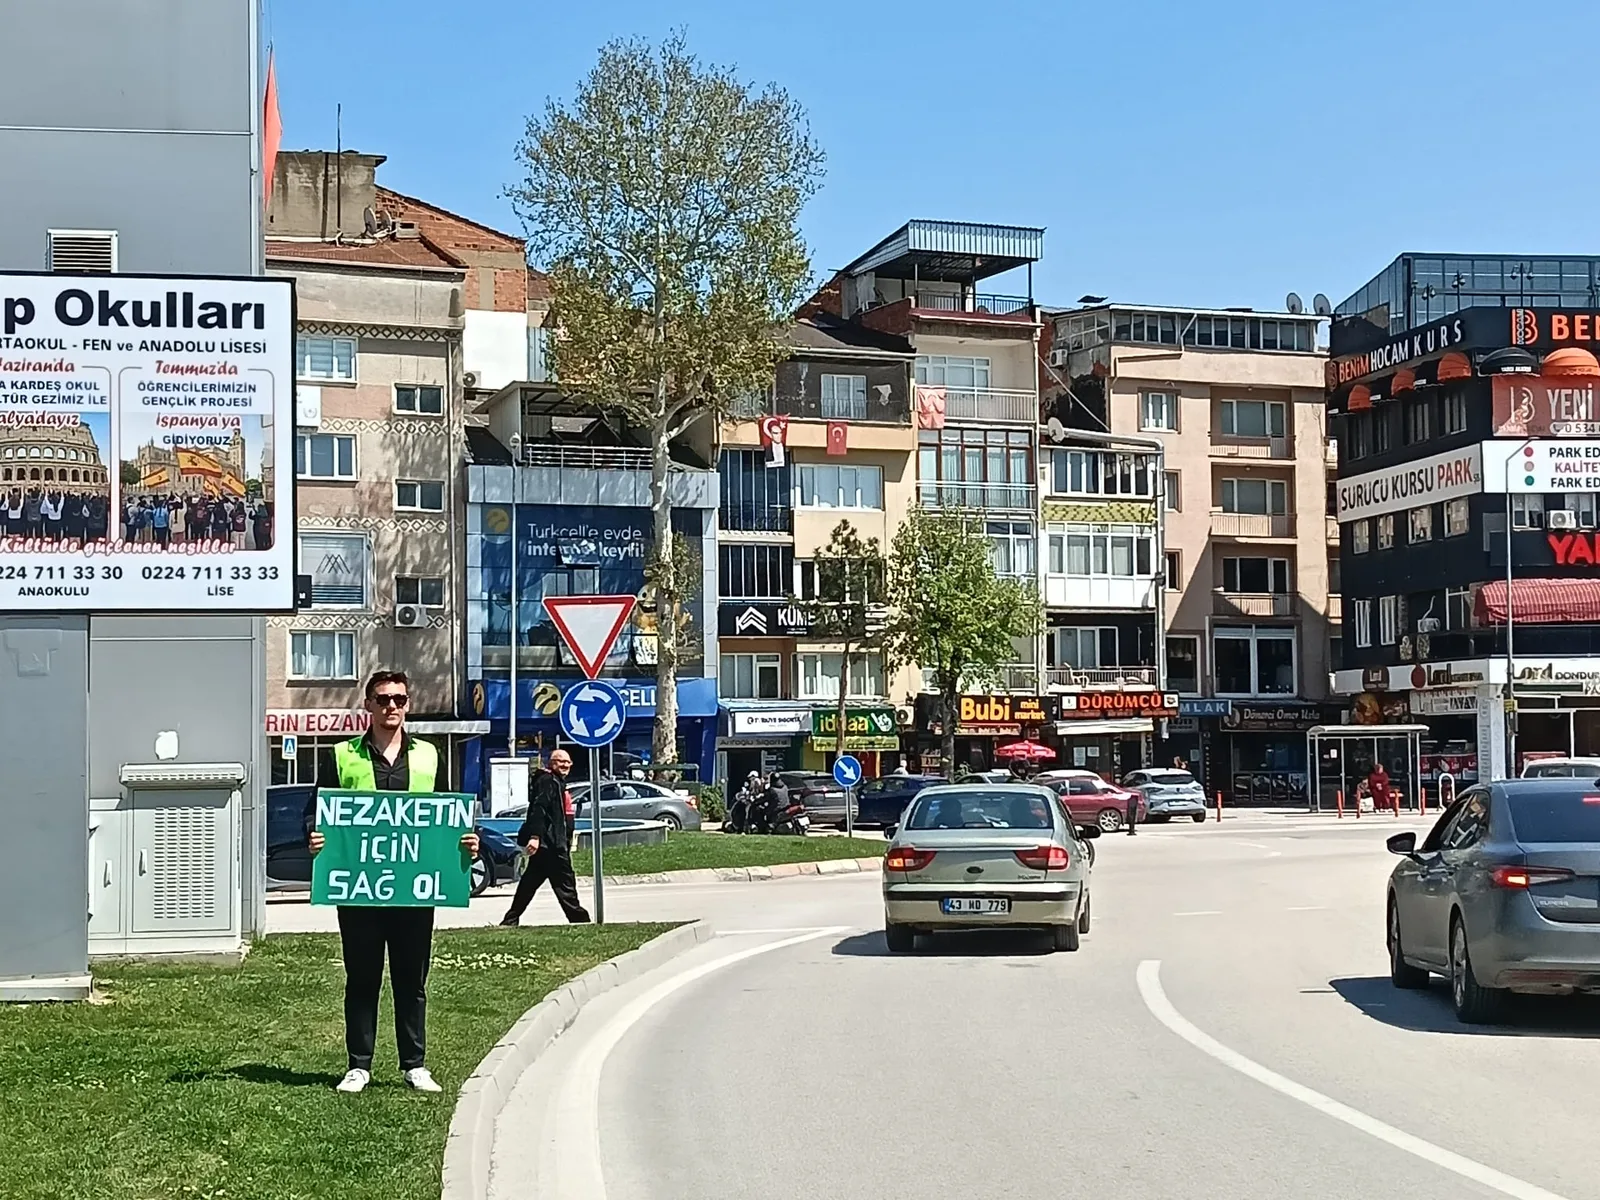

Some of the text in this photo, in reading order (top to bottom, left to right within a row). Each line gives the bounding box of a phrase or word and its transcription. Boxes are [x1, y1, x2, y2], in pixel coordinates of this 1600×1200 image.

[54, 288, 265, 330] Okulları
[83, 339, 112, 351] FEN
[117, 342, 133, 351] ve
[138, 340, 216, 353] ANADOLU
[220, 338, 267, 354] LİSESİ
[1370, 339, 1409, 372] HOCAM
[155, 360, 238, 376] Temmuz'da
[11, 380, 61, 393] KARDEŞ
[65, 381, 100, 391] OKUL
[137, 380, 257, 393] ÖĞRENCİLERİMİZİN
[0, 393, 107, 405] TÜR GEZİMİZ İLE
[142, 395, 252, 408] GENÇLİK PROJESİ
[1546, 383, 1593, 420] YENİ
[162, 433, 231, 446] GİDİYORUZ
[1549, 447, 1581, 458] PARK
[1391, 466, 1434, 500] KURSU
[1437, 457, 1473, 489] PARK
[1551, 477, 1582, 488] FARK
[603, 525, 642, 540] evde
[0, 537, 237, 558] Kültürle güçlenen nesiller
[34, 566, 65, 580] 711
[73, 566, 95, 580] 33
[101, 566, 123, 580] 30
[141, 566, 279, 580] 0224 711 33 33
[18, 586, 90, 597] ANAOKULU
[207, 584, 235, 597] LİSE
[1080, 693, 1161, 709] DÜRÜMCÜ
[961, 697, 1011, 720] Bubi
[306, 714, 373, 732] ECZAN
[327, 870, 447, 900] SAĞ OL
[988, 900, 1006, 911] 779
